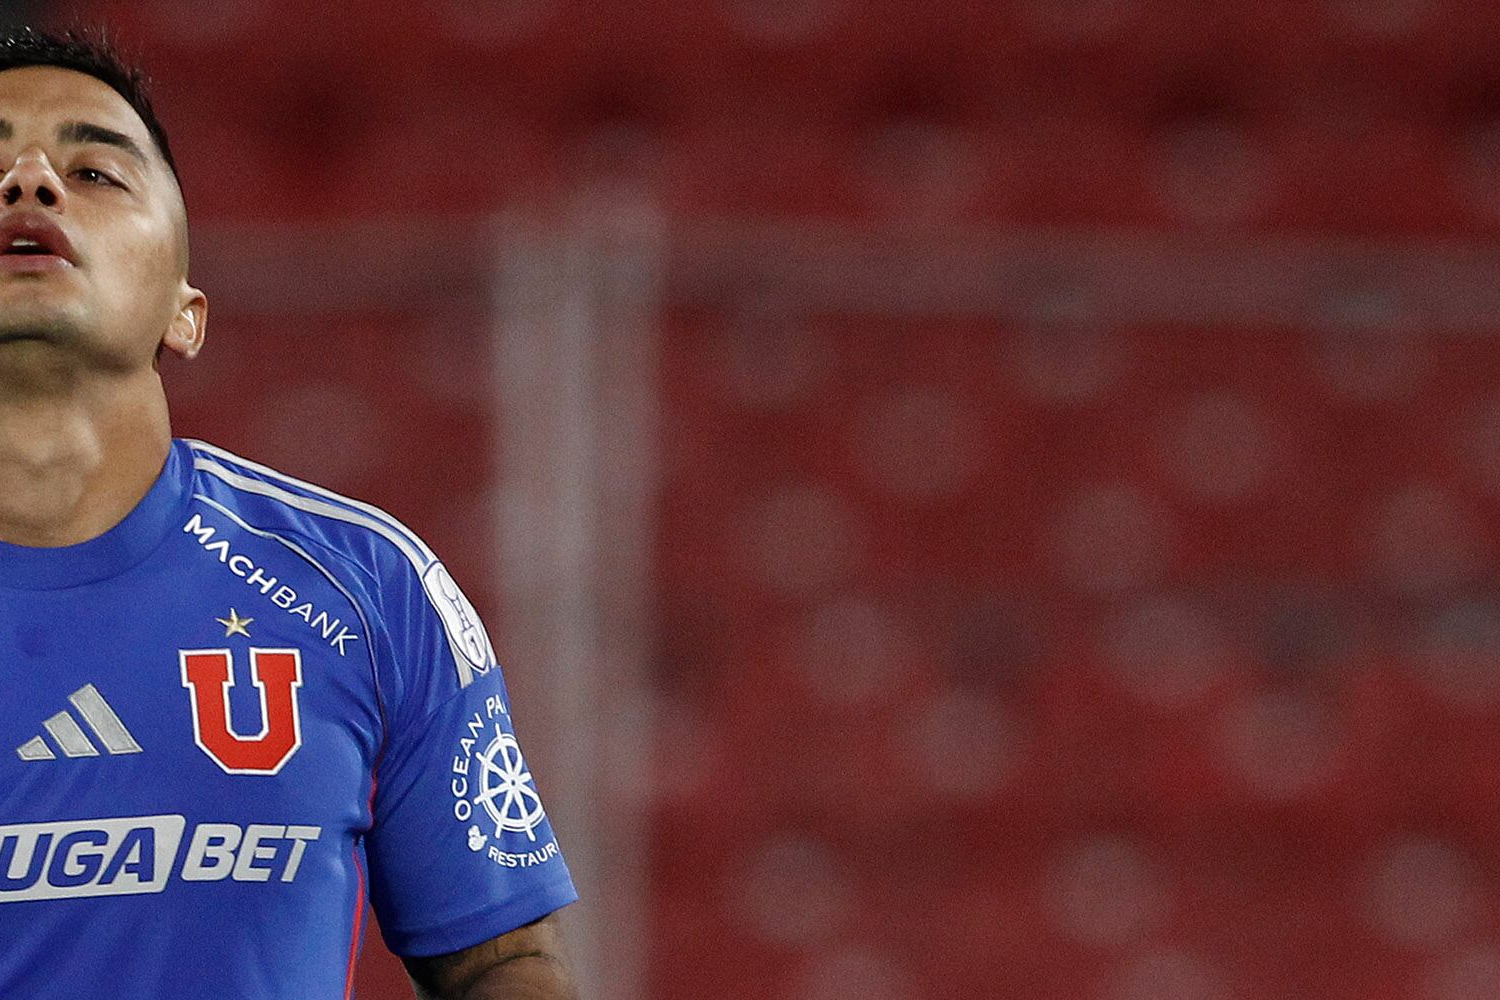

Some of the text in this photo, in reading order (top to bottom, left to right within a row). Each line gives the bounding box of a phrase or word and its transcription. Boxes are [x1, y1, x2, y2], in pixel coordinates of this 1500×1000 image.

[184, 514, 358, 656] MACHBANK
[179, 648, 303, 775] U
[452, 694, 511, 821] OCEAN PA
[488, 836, 560, 868] RESTAUR
